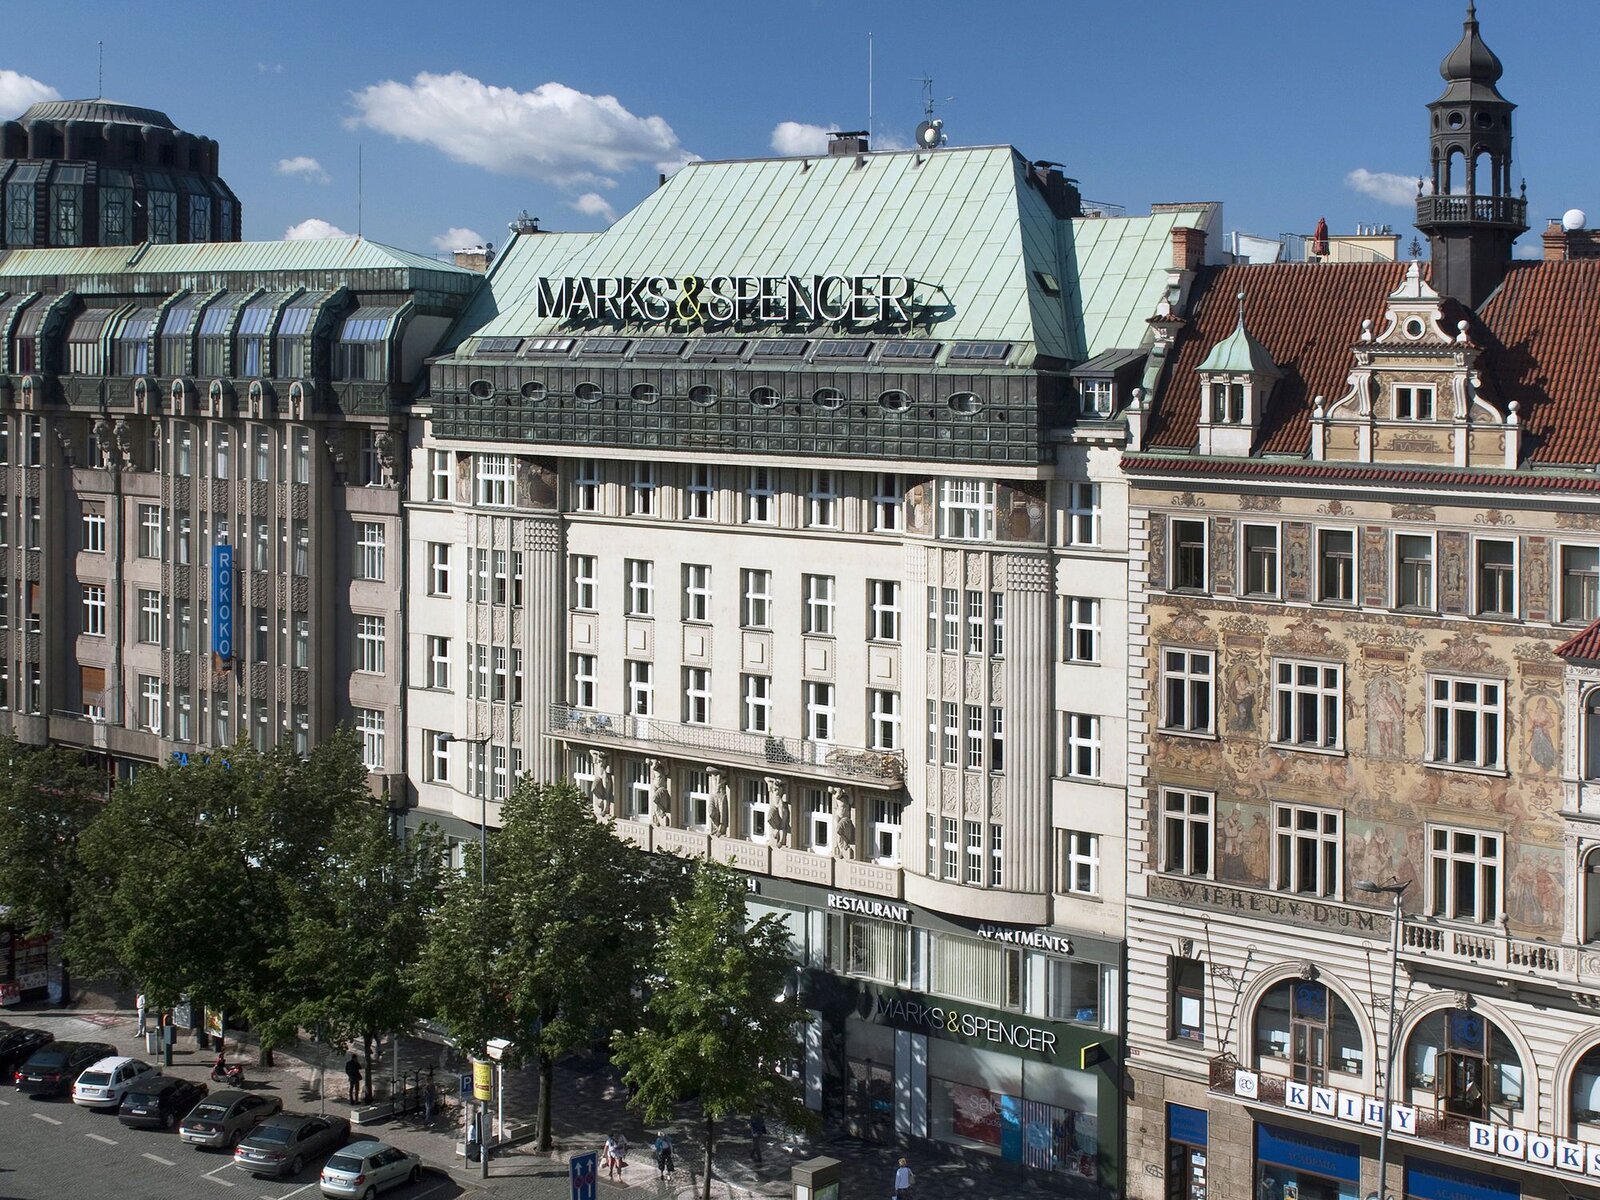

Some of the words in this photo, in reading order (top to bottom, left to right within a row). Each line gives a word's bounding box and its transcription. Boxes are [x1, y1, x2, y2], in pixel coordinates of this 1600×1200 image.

[535, 274, 911, 322] MARKS&SPENCER
[219, 552, 230, 655] ROKOKO
[827, 893, 909, 921] RESTAURANT
[977, 923, 1070, 953] APARTMENTS
[877, 998, 1057, 1054] MARKS&SPENCER
[1290, 1087, 1411, 1129] KNIHY
